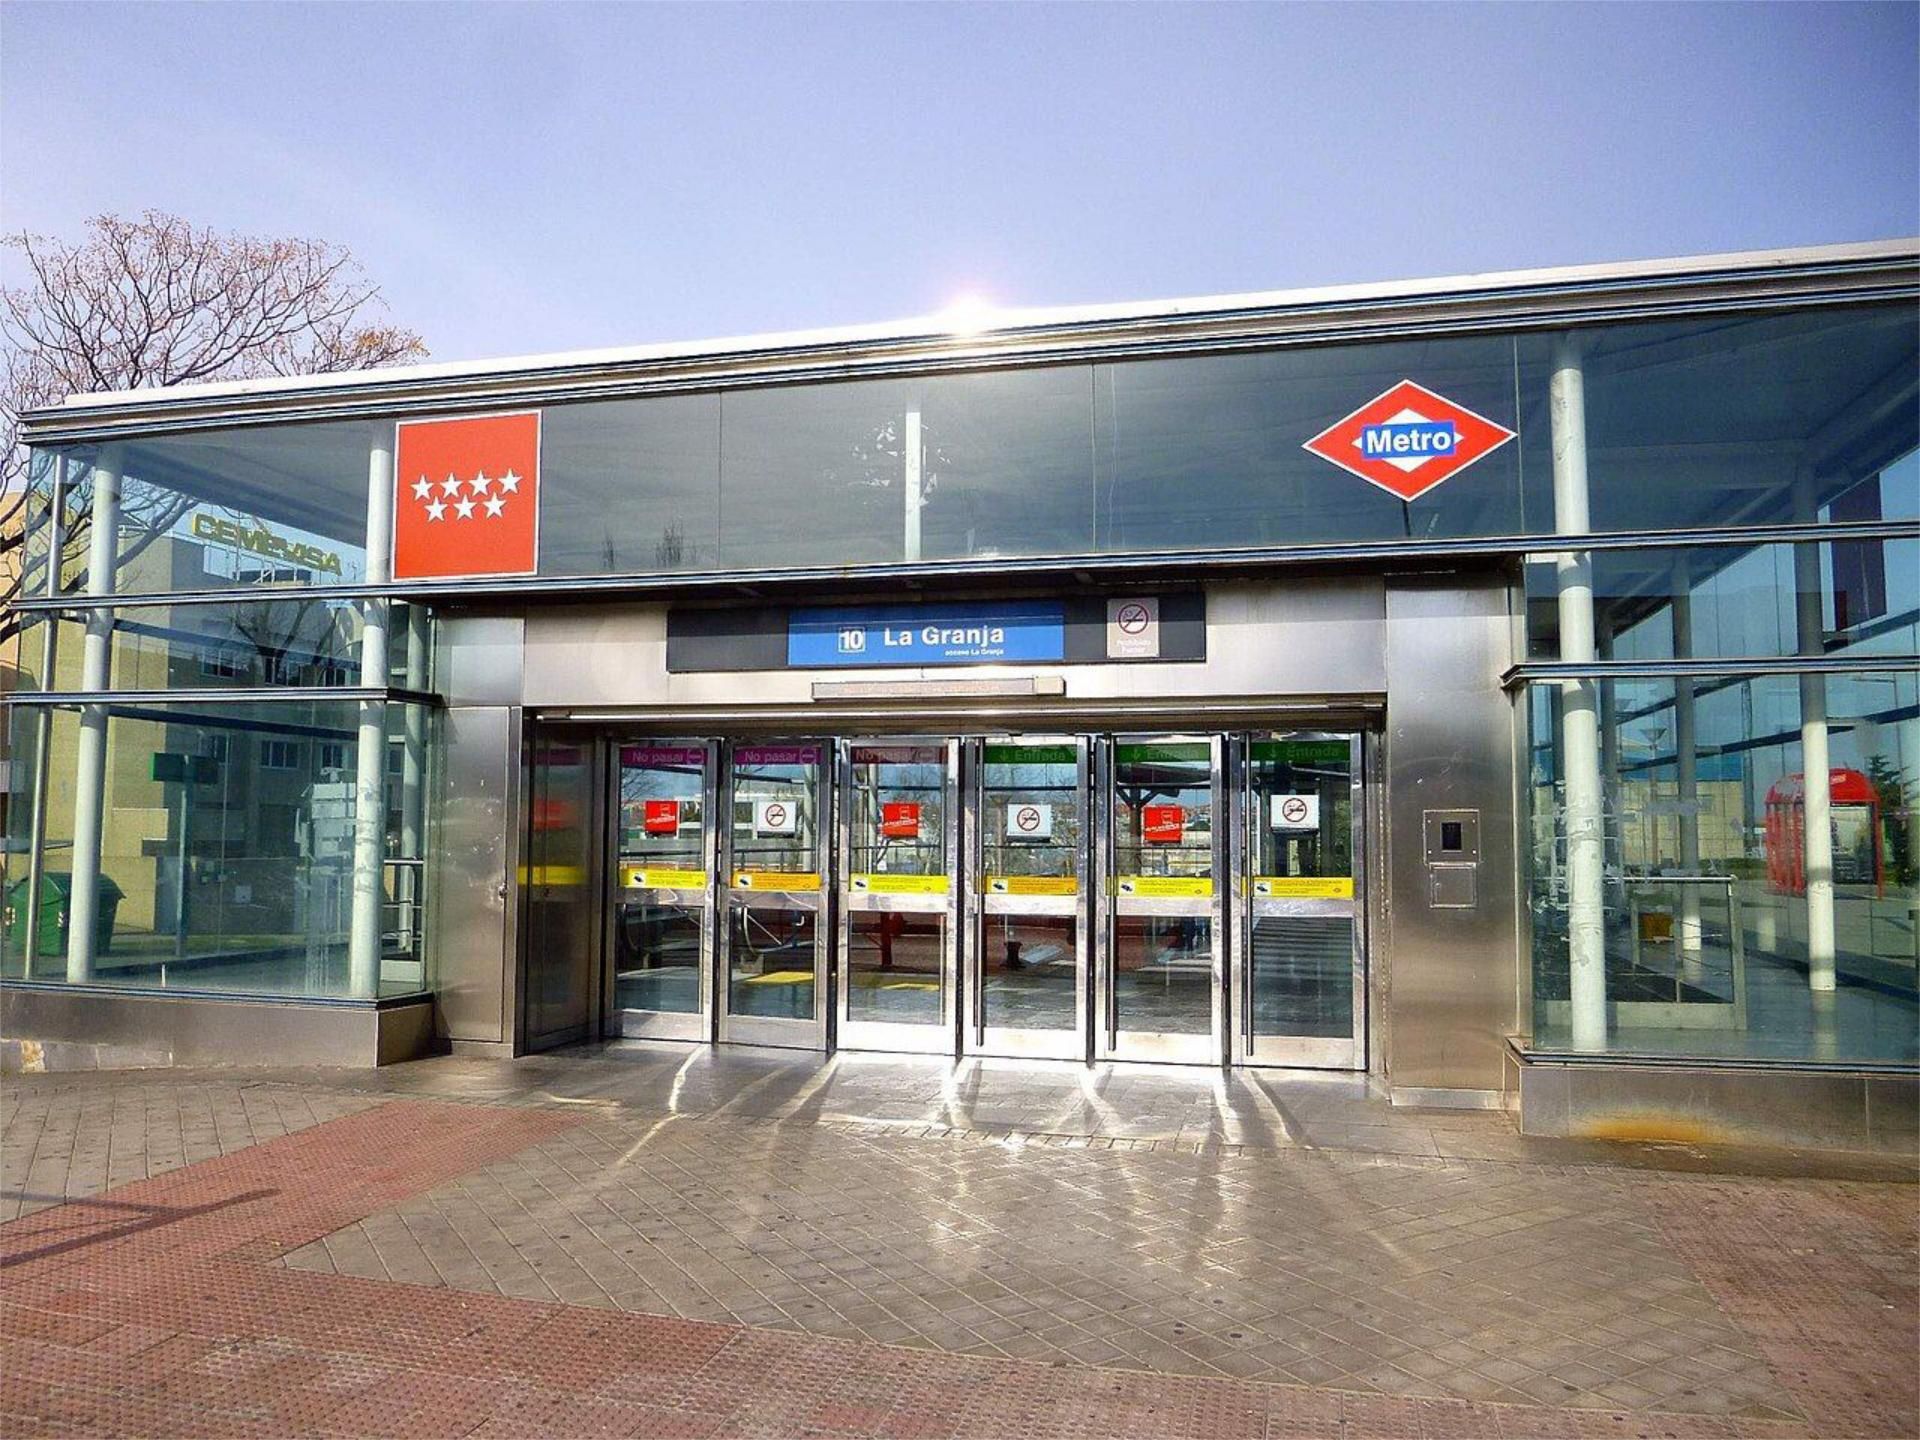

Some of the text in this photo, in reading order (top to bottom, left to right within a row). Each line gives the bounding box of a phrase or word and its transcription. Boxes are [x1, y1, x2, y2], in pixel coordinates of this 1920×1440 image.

[1366, 429, 1451, 454] Metro
[840, 626, 1004, 649] 10 La Granja
[632, 751, 684, 764] No pasar
[745, 751, 797, 763] No pasar
[856, 749, 874, 761] No
[1015, 748, 1067, 761] Entrada
